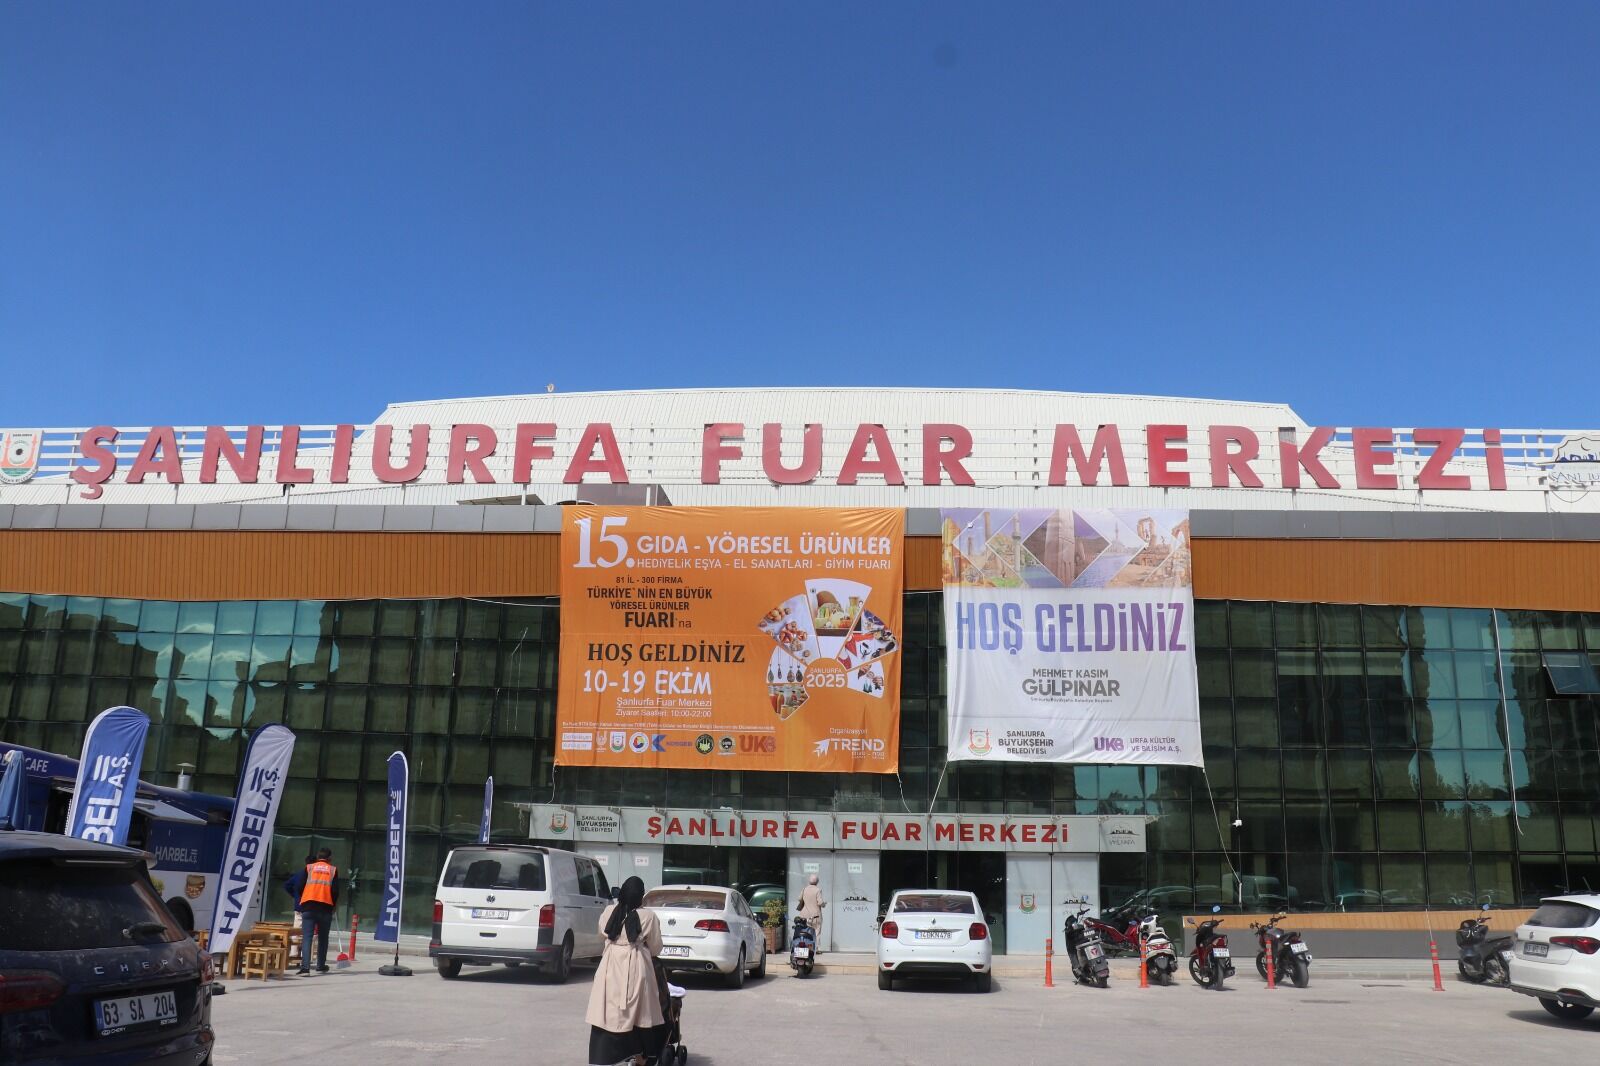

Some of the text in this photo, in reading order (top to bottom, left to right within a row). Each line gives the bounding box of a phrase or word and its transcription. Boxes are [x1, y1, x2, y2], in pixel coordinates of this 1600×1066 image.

[70, 423, 629, 499] ŞANLIURFA
[701, 423, 976, 485] FUAR
[573, 516, 891, 568] 15. GIDA YÖRESEL ÜRÜNLER
[694, 558, 722, 571] EŞYA
[734, 558, 747, 569] EL
[751, 559, 813, 569] SANATLARI
[858, 559, 891, 569] FUARI
[616, 574, 683, 584] 81 İL 300 FİRMA
[659, 588, 673, 599] EN
[675, 586, 713, 599] BÜYÜK
[610, 600, 690, 611] YÖRESEL ÜRÜNLER
[955, 602, 1023, 655] HOŞ
[587, 640, 745, 666] HOŞ GELDİNİZ
[583, 666, 712, 695] 10-19 EKİM
[806, 673, 846, 688] 2025
[1032, 668, 1108, 678] MEHMET KASIM
[1021, 678, 1120, 697] GÜLPINAR
[616, 697, 712, 707] Şanlıurfa Fuar Merkezi
[615, 709, 639, 718] Ziyaret
[1006, 730, 1046, 738] ŞANLIURFA
[1149, 736, 1176, 744] KÜLTÜR
[830, 738, 885, 751] TREND
[1093, 736, 1125, 752] UKB
[25, 757, 49, 772] CAFE
[647, 817, 819, 839] ŞANLIURFA
[841, 821, 922, 841] FUAR
[93, 957, 184, 975] CHERY
[103, 994, 176, 1026] 63 SA 204
